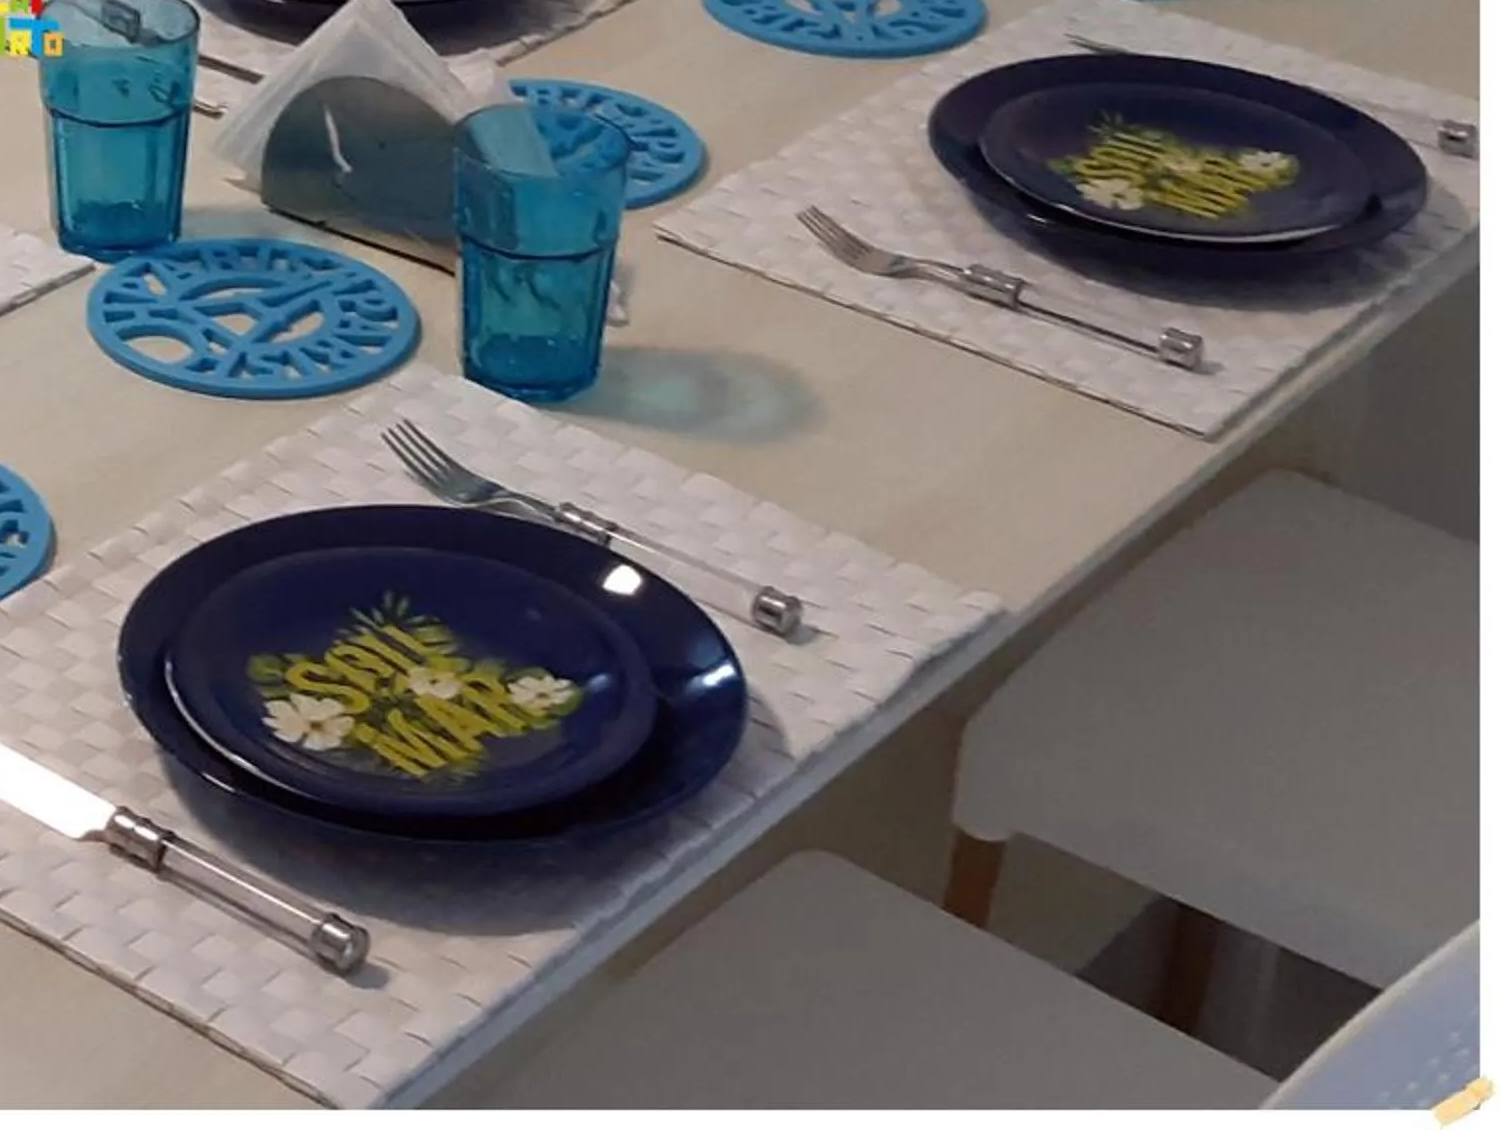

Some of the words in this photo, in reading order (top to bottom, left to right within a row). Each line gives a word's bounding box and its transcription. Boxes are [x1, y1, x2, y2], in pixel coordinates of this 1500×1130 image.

[104, 246, 342, 302] PARIS
[246, 289, 397, 380] PARIS
[353, 672, 536, 776] MAR
